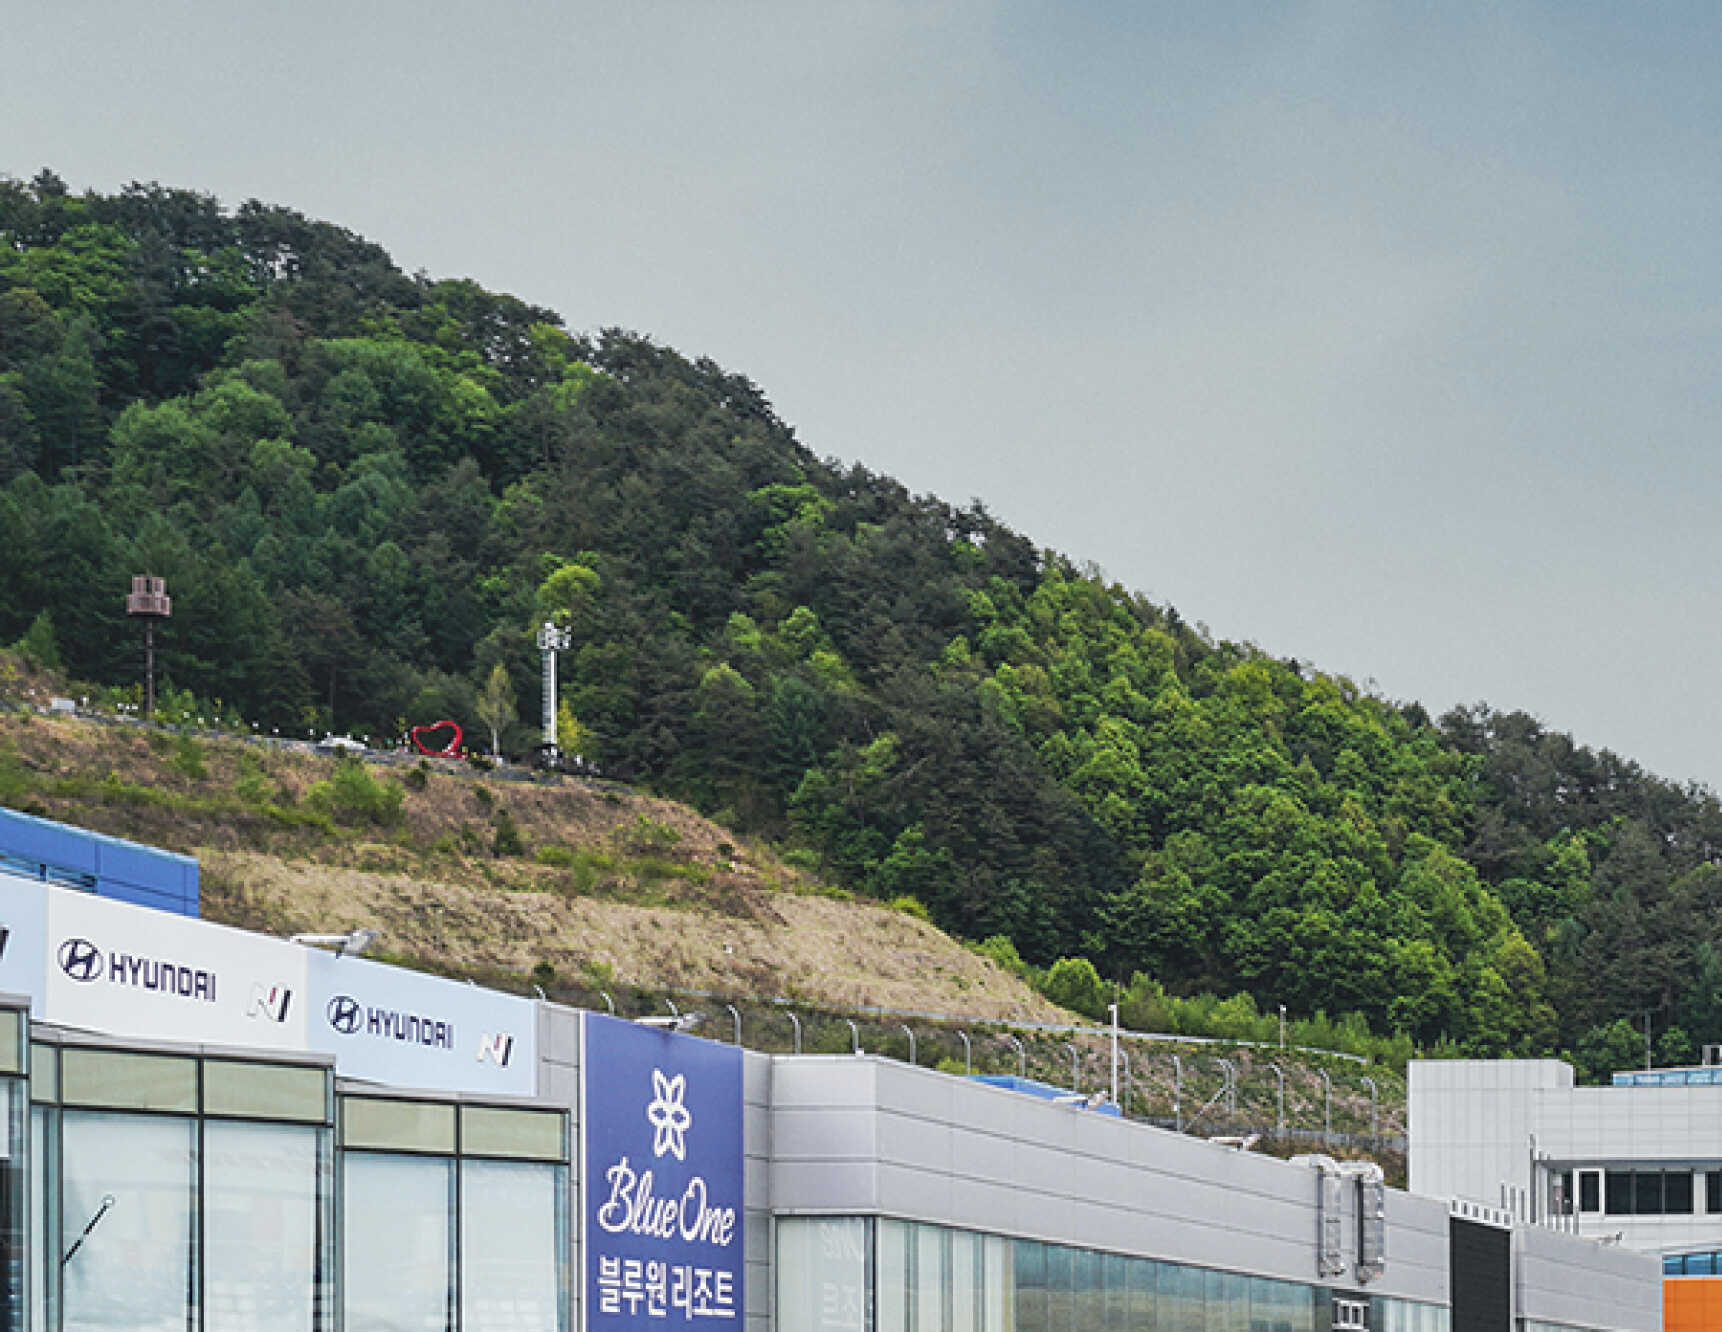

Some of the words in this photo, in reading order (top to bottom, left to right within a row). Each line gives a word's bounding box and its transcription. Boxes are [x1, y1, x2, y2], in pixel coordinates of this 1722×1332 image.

[108, 952, 217, 1002] HYUNDAI
[366, 1007, 454, 1049] HYUNDAI
[597, 1256, 667, 1318] 블루원
[672, 1265, 736, 1320] 리조트
